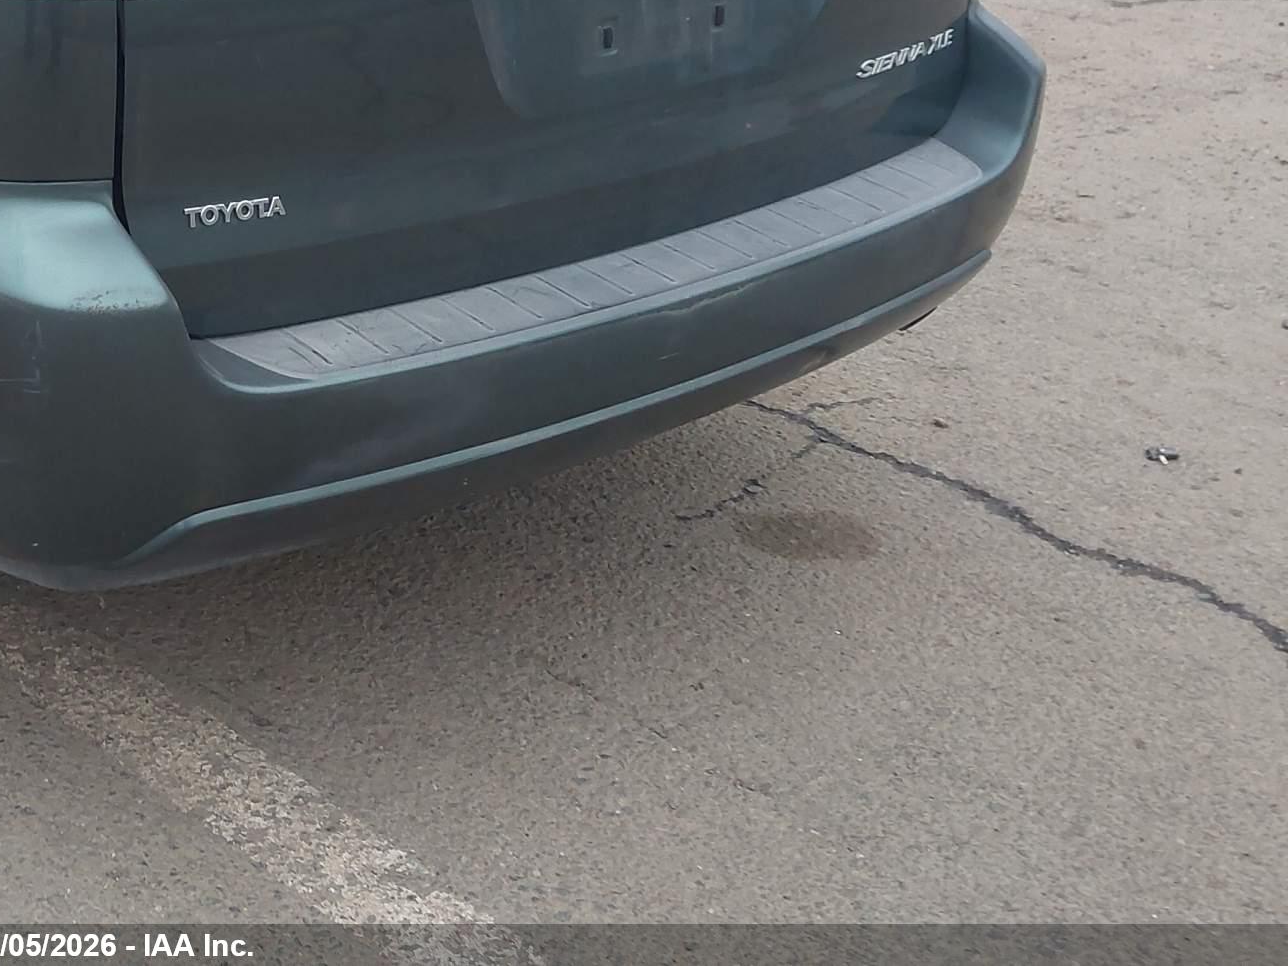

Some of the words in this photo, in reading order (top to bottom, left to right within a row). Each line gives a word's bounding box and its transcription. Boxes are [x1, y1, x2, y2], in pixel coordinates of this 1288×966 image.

[856, 41, 927, 78] SIENNA
[927, 28, 955, 55] XLE
[184, 196, 286, 228] TOYOTA
